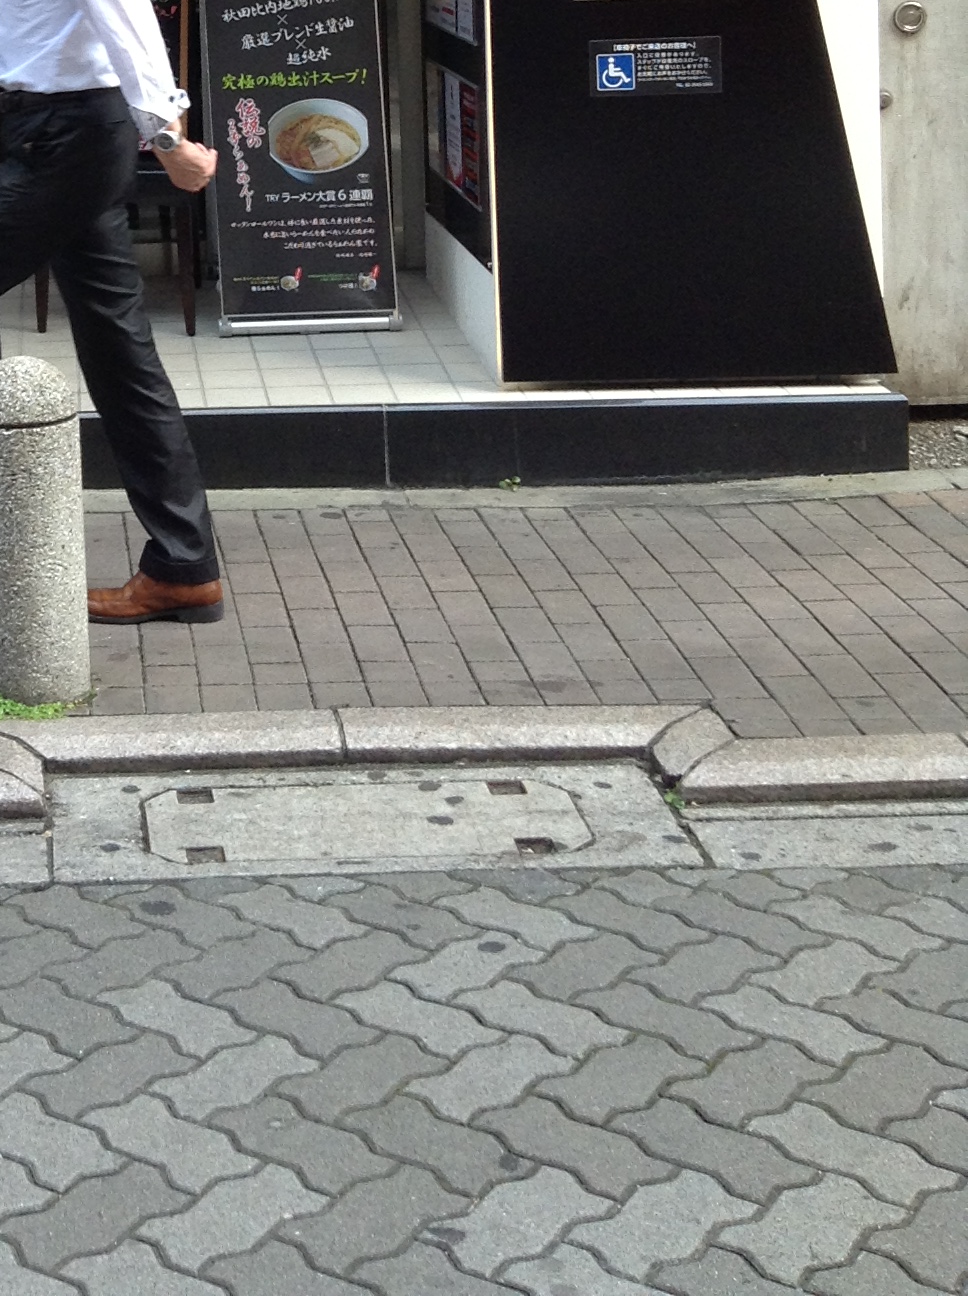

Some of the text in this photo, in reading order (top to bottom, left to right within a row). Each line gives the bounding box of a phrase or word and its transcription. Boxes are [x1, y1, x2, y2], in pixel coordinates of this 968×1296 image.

[240, 15, 355, 51] 厳選ブレンド生醤油
[286, 46, 332, 66] 超純水
[235, 97, 266, 149] 伝説の
[265, 193, 280, 203] TRY
